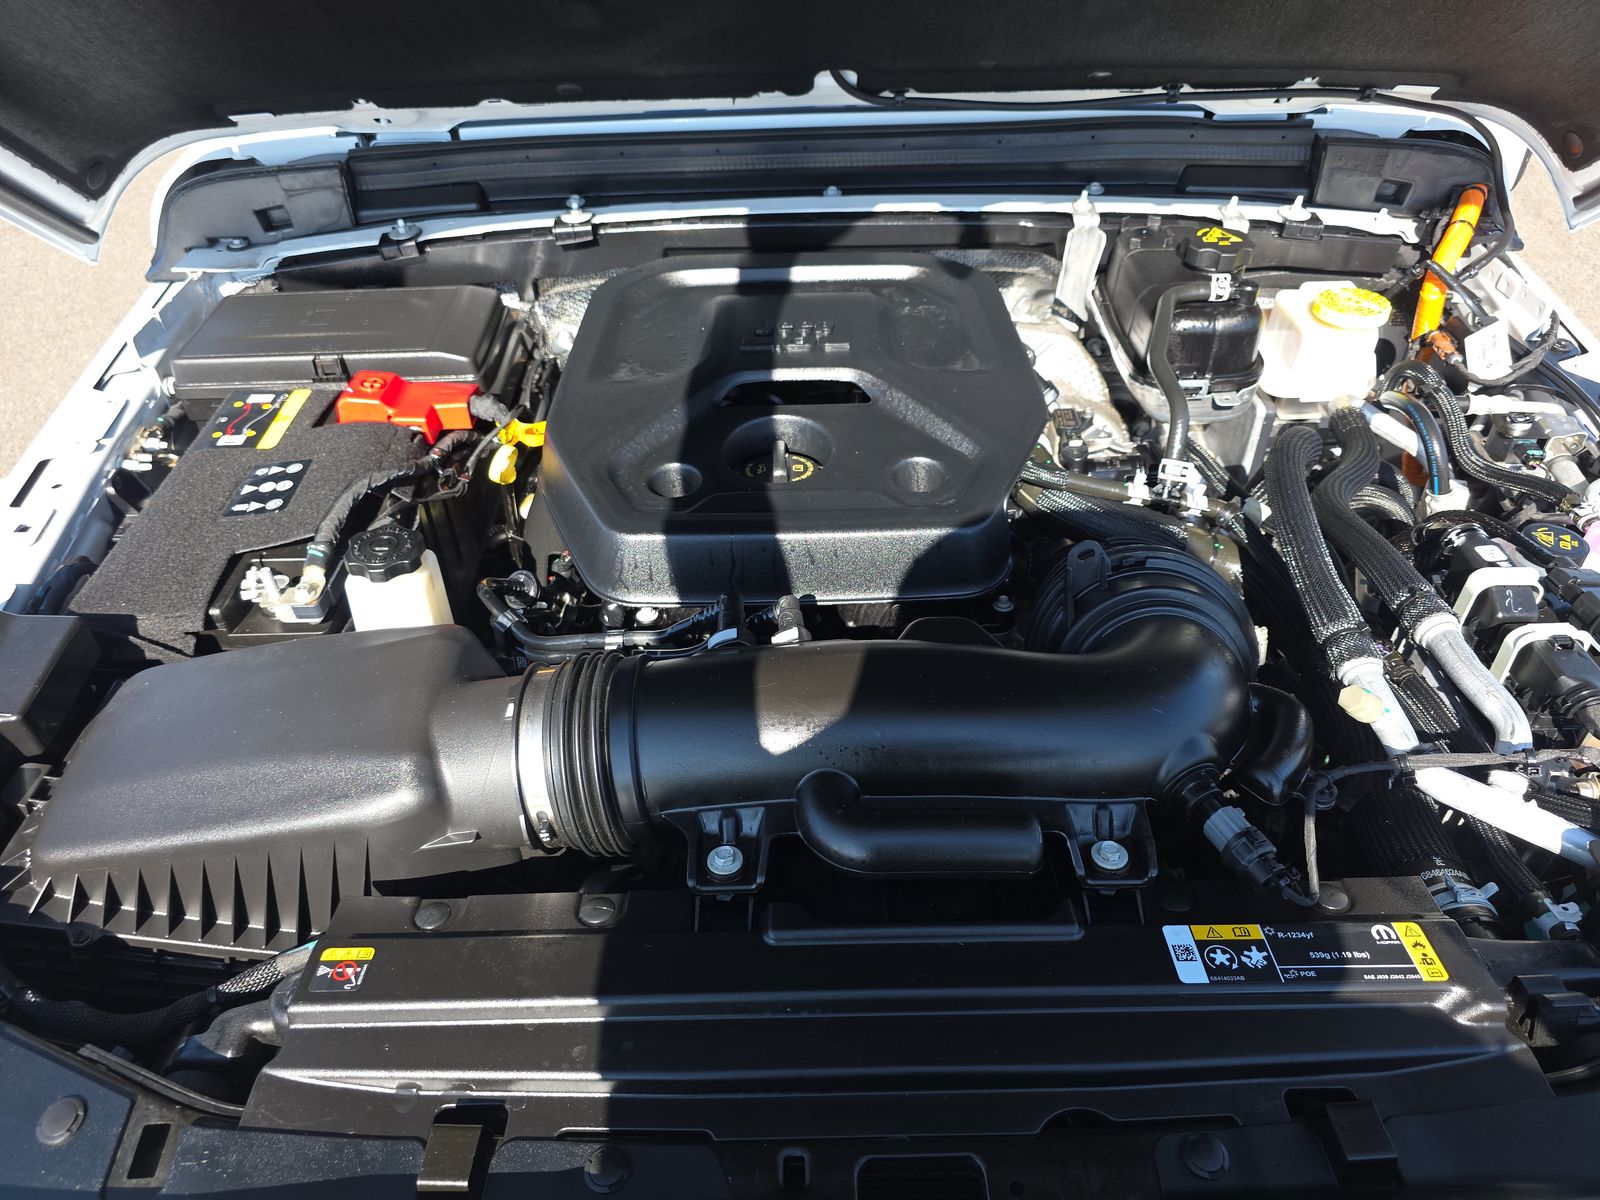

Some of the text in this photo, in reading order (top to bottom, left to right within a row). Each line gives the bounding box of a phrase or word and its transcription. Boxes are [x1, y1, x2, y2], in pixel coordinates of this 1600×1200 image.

[1277, 931, 1314, 940] R-1234yf
[1309, 950, 1371, 960] 539g (1.19 lbs)
